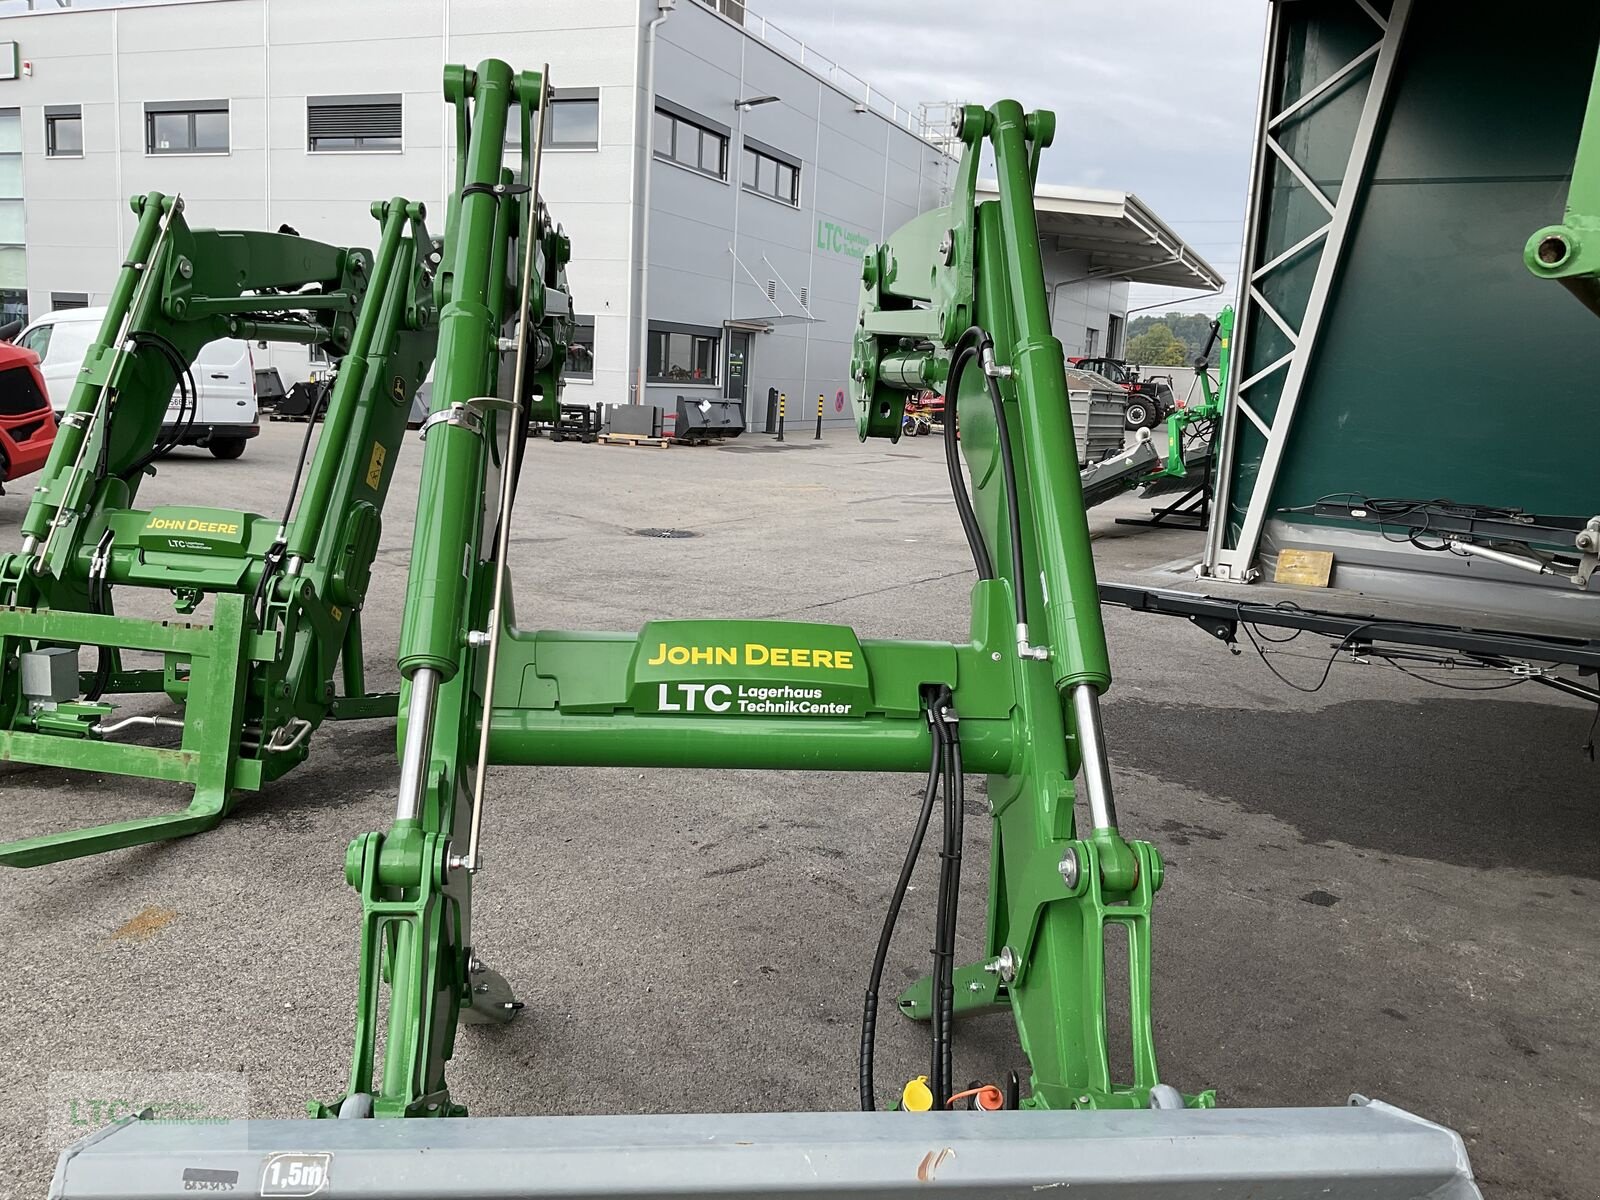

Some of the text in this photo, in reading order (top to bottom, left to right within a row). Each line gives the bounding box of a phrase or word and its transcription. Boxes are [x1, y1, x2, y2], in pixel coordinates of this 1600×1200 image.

[817, 220, 842, 253] LTC
[146, 518, 239, 534] JOHN DEERE
[168, 540, 186, 548] LTC
[648, 643, 853, 669] JOHN DEERE
[658, 684, 732, 712] LTC
[738, 685, 822, 699] Lagerhaus
[738, 699, 852, 714] TechnikCenter
[270, 1161, 323, 1188] 1,5m
